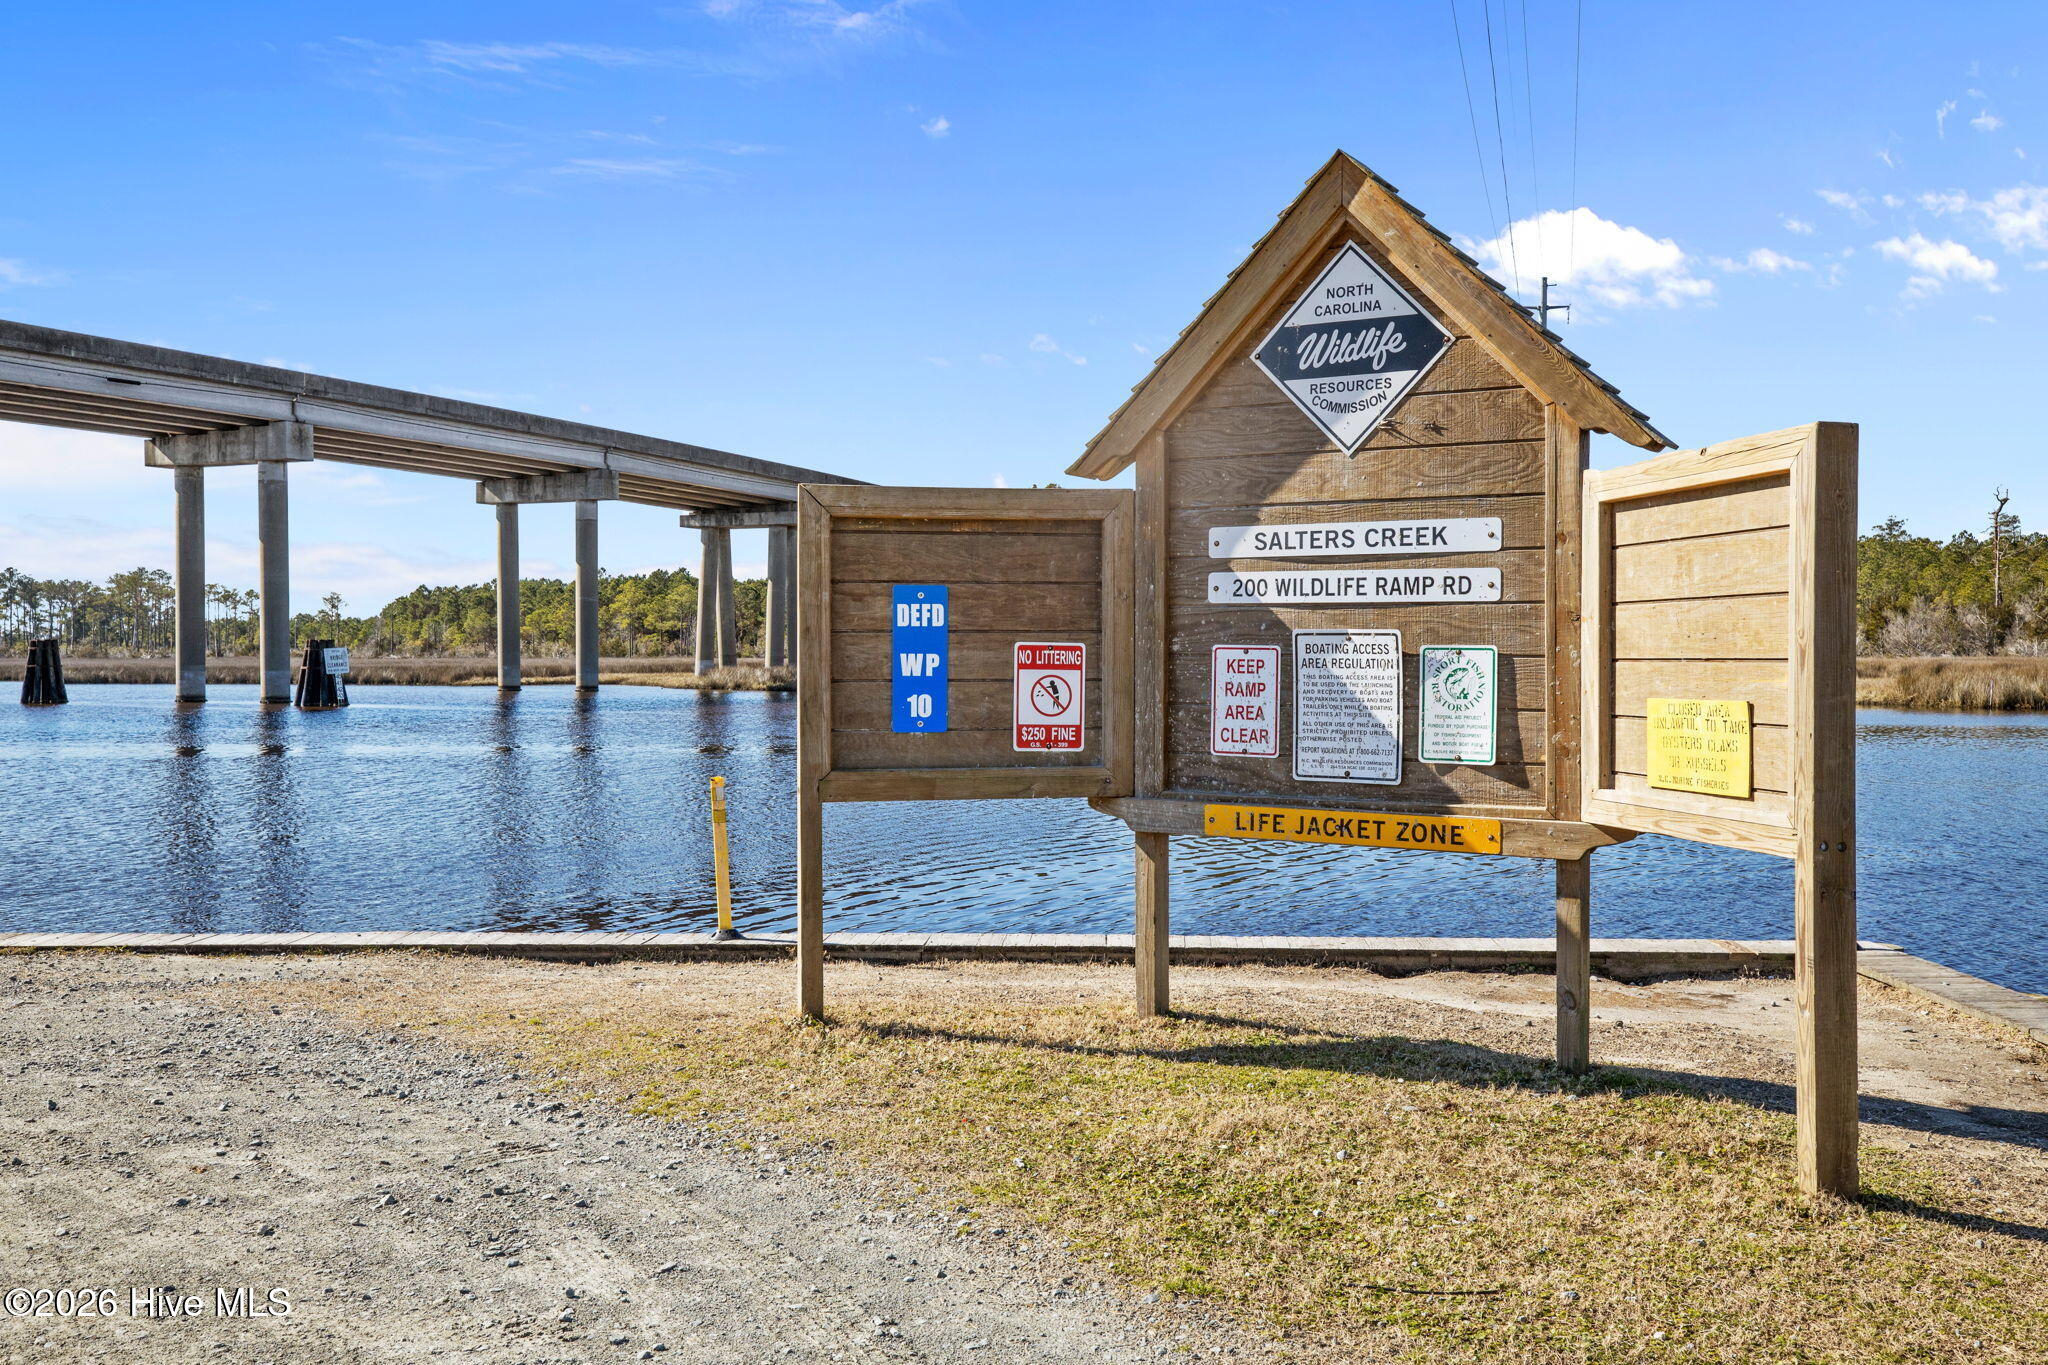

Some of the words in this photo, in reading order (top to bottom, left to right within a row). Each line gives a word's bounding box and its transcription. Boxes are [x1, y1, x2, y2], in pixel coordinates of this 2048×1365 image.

[1326, 283, 1374, 299] NORTH
[1314, 300, 1382, 317] CAROLINA
[1297, 321, 1407, 371] Wildlife
[1309, 377, 1392, 395] RESOURCES
[1311, 390, 1388, 414] COMMISSION
[1254, 528, 1355, 551] SALTERS
[1364, 525, 1449, 548] CREEK
[1232, 578, 1268, 598] 200
[1275, 577, 1368, 597] WILDLIFE
[1375, 576, 1435, 596] RAMP
[1442, 575, 1472, 596] RD
[896, 603, 945, 627] DEFD
[1018, 649, 1032, 664] NO
[1036, 650, 1082, 665] LITTERING
[1305, 643, 1349, 655] BOATING
[1352, 643, 1390, 655] ACCESS
[900, 653, 940, 677] WP
[1226, 658, 1265, 674] KEEP
[1301, 657, 1328, 670] AREA
[1331, 658, 1394, 670] REGULATION
[1432, 655, 1462, 679] SPORT
[1465, 658, 1485, 680] FISH
[1224, 681, 1266, 697] RAMP
[1431, 682, 1486, 712] RESTORATION
[906, 693, 933, 719] 10
[1224, 705, 1266, 721] AREA
[1667, 702, 1702, 717] CLOSED
[1706, 704, 1731, 718] AREA
[1021, 726, 1046, 741] $250
[1051, 727, 1076, 741] FINE
[1653, 717, 1698, 731] UNLAWFUL
[1704, 718, 1717, 732] TO
[1723, 719, 1748, 735] TAKE
[1220, 727, 1269, 744] CLEAR
[1662, 735, 1702, 750] OYSTERS
[1707, 739, 1738, 753] CLAMS
[1321, 747, 1348, 755] VIOLATIONS
[1356, 748, 1394, 756] 1-800-662-7137
[1685, 756, 1727, 773] MUSSELS
[1696, 778, 1730, 791] FISHERIES
[1235, 811, 1286, 834] LIFE
[1294, 815, 1386, 841] JACKET
[1396, 820, 1465, 846] ZONE
